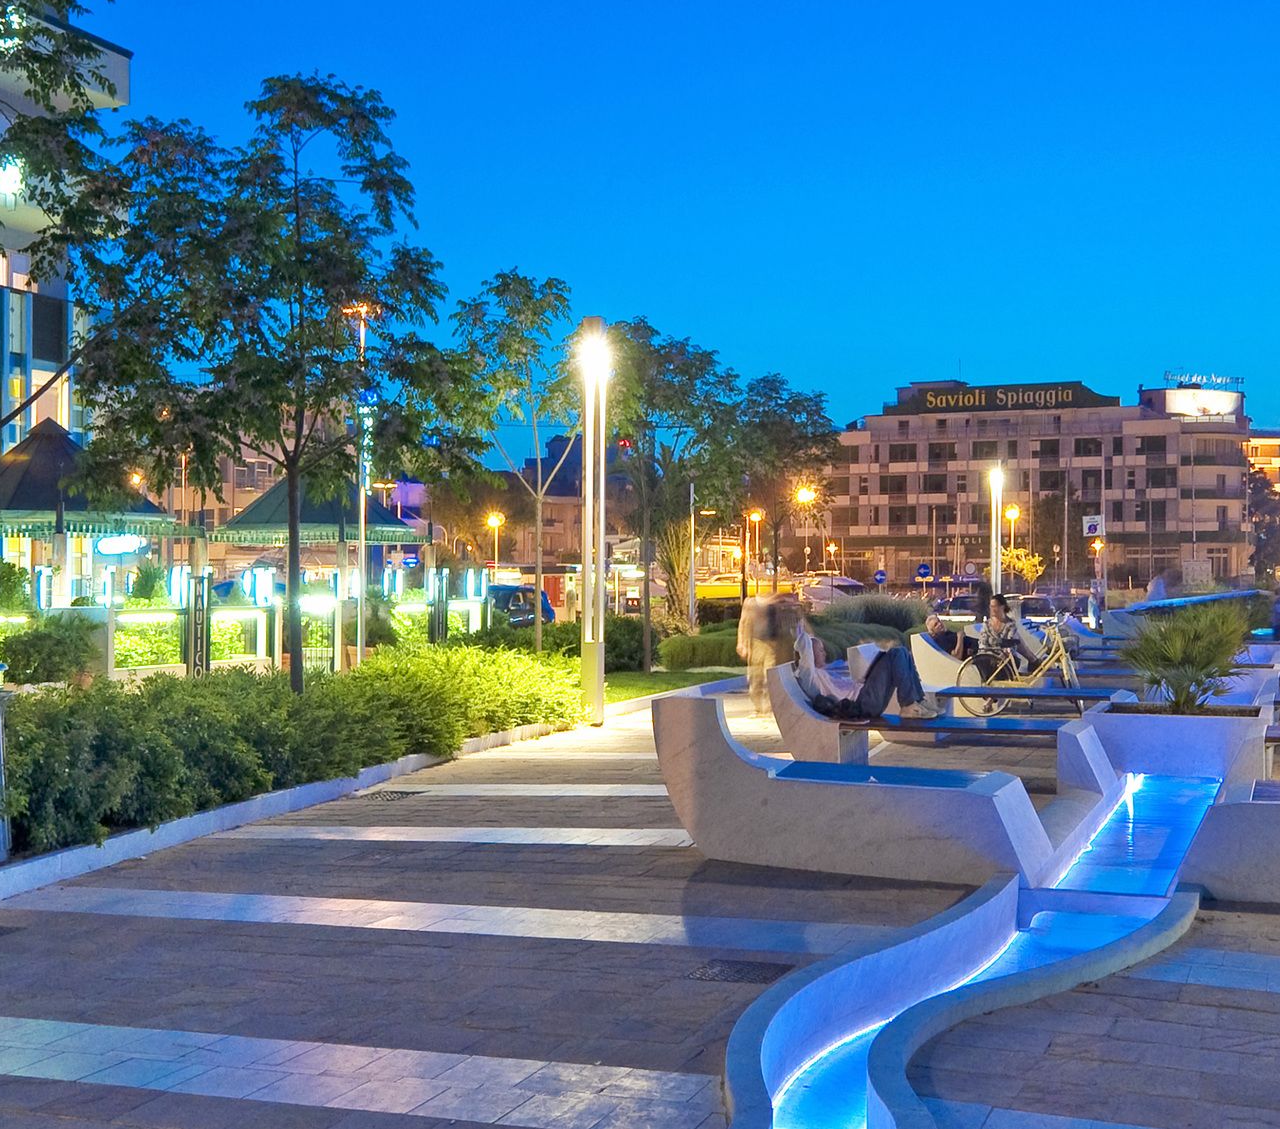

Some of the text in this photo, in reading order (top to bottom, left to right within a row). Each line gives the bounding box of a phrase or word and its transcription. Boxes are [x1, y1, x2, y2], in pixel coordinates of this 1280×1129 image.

[926, 387, 1073, 408] Savioli Spiaggia
[194, 582, 203, 679] NAUTICO
